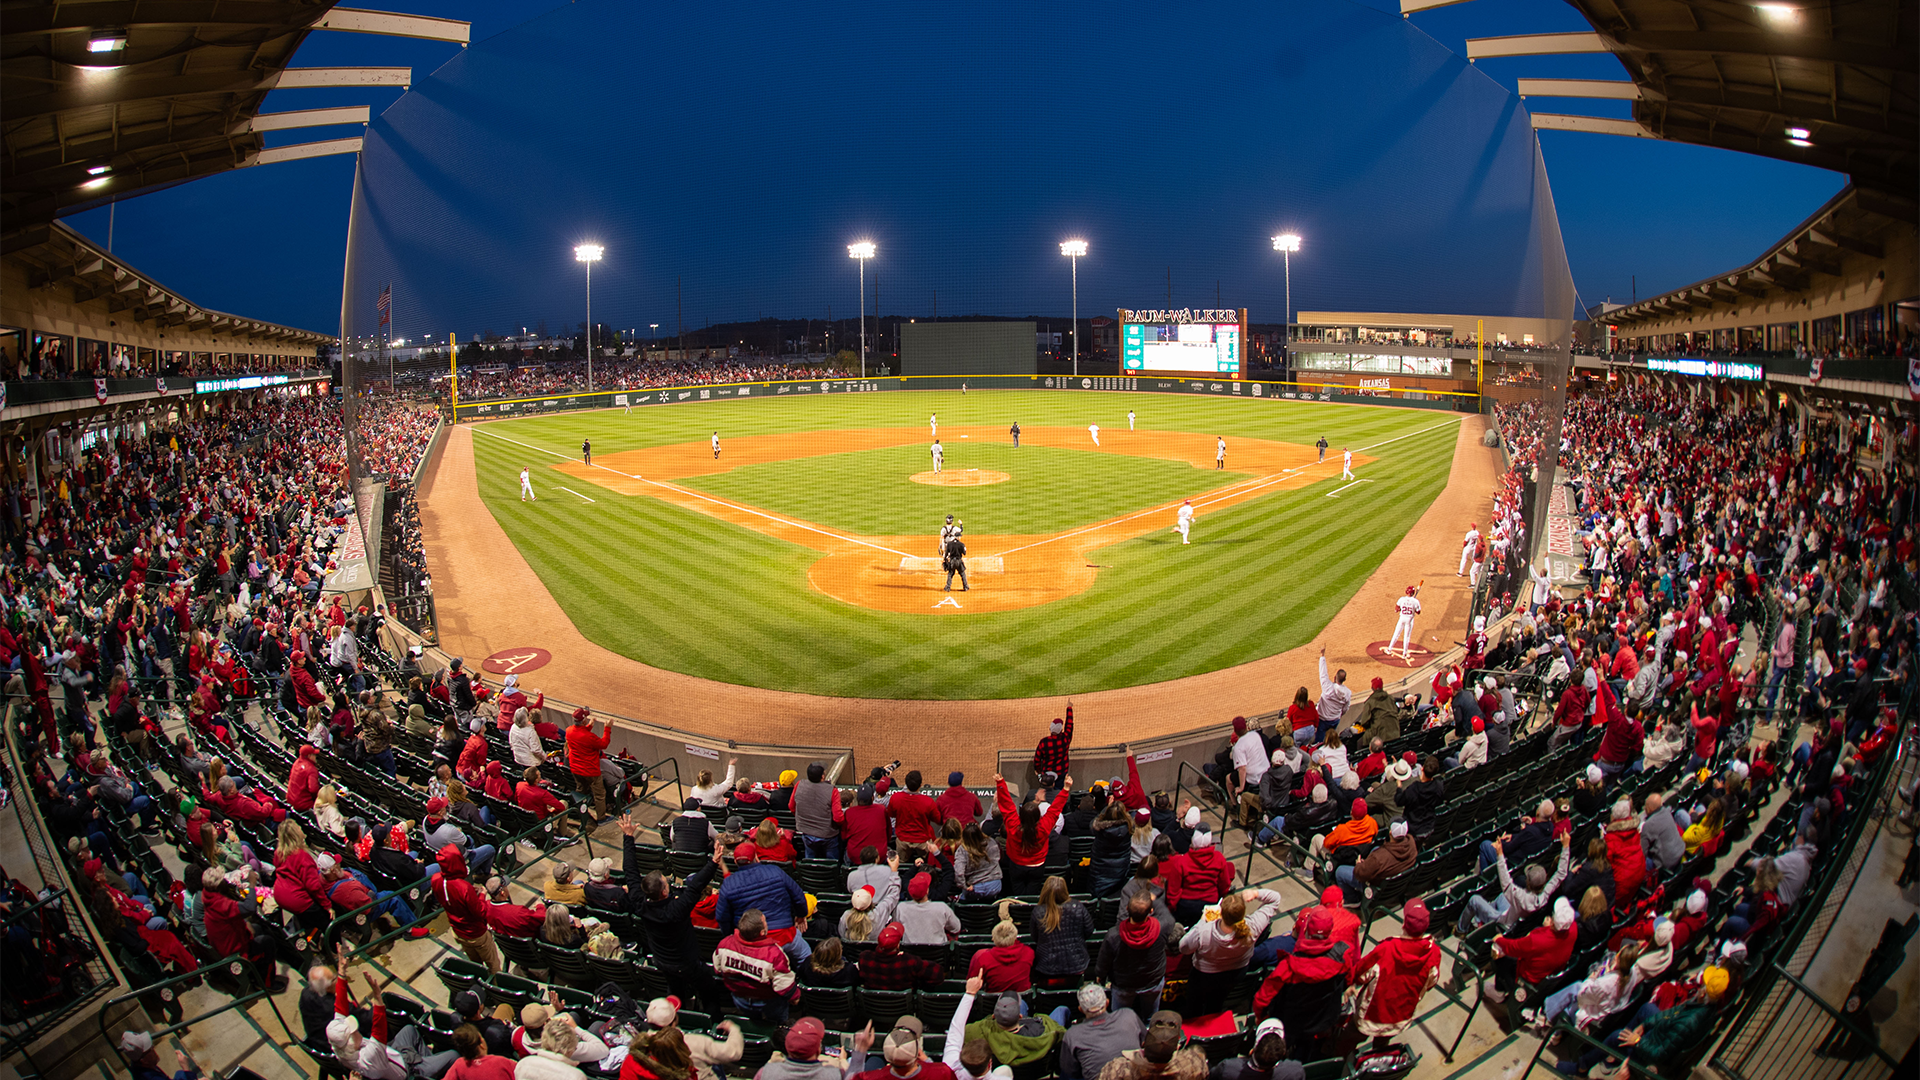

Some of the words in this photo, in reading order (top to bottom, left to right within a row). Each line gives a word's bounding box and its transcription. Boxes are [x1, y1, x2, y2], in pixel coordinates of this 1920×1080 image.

[1124, 307, 1238, 325] BAUM-WALKER
[1359, 378, 1390, 388] ARKANSAS
[1401, 606, 1413, 615] 25
[1477, 641, 1485, 655] 2
[725, 956, 763, 978] ARKANSAS
